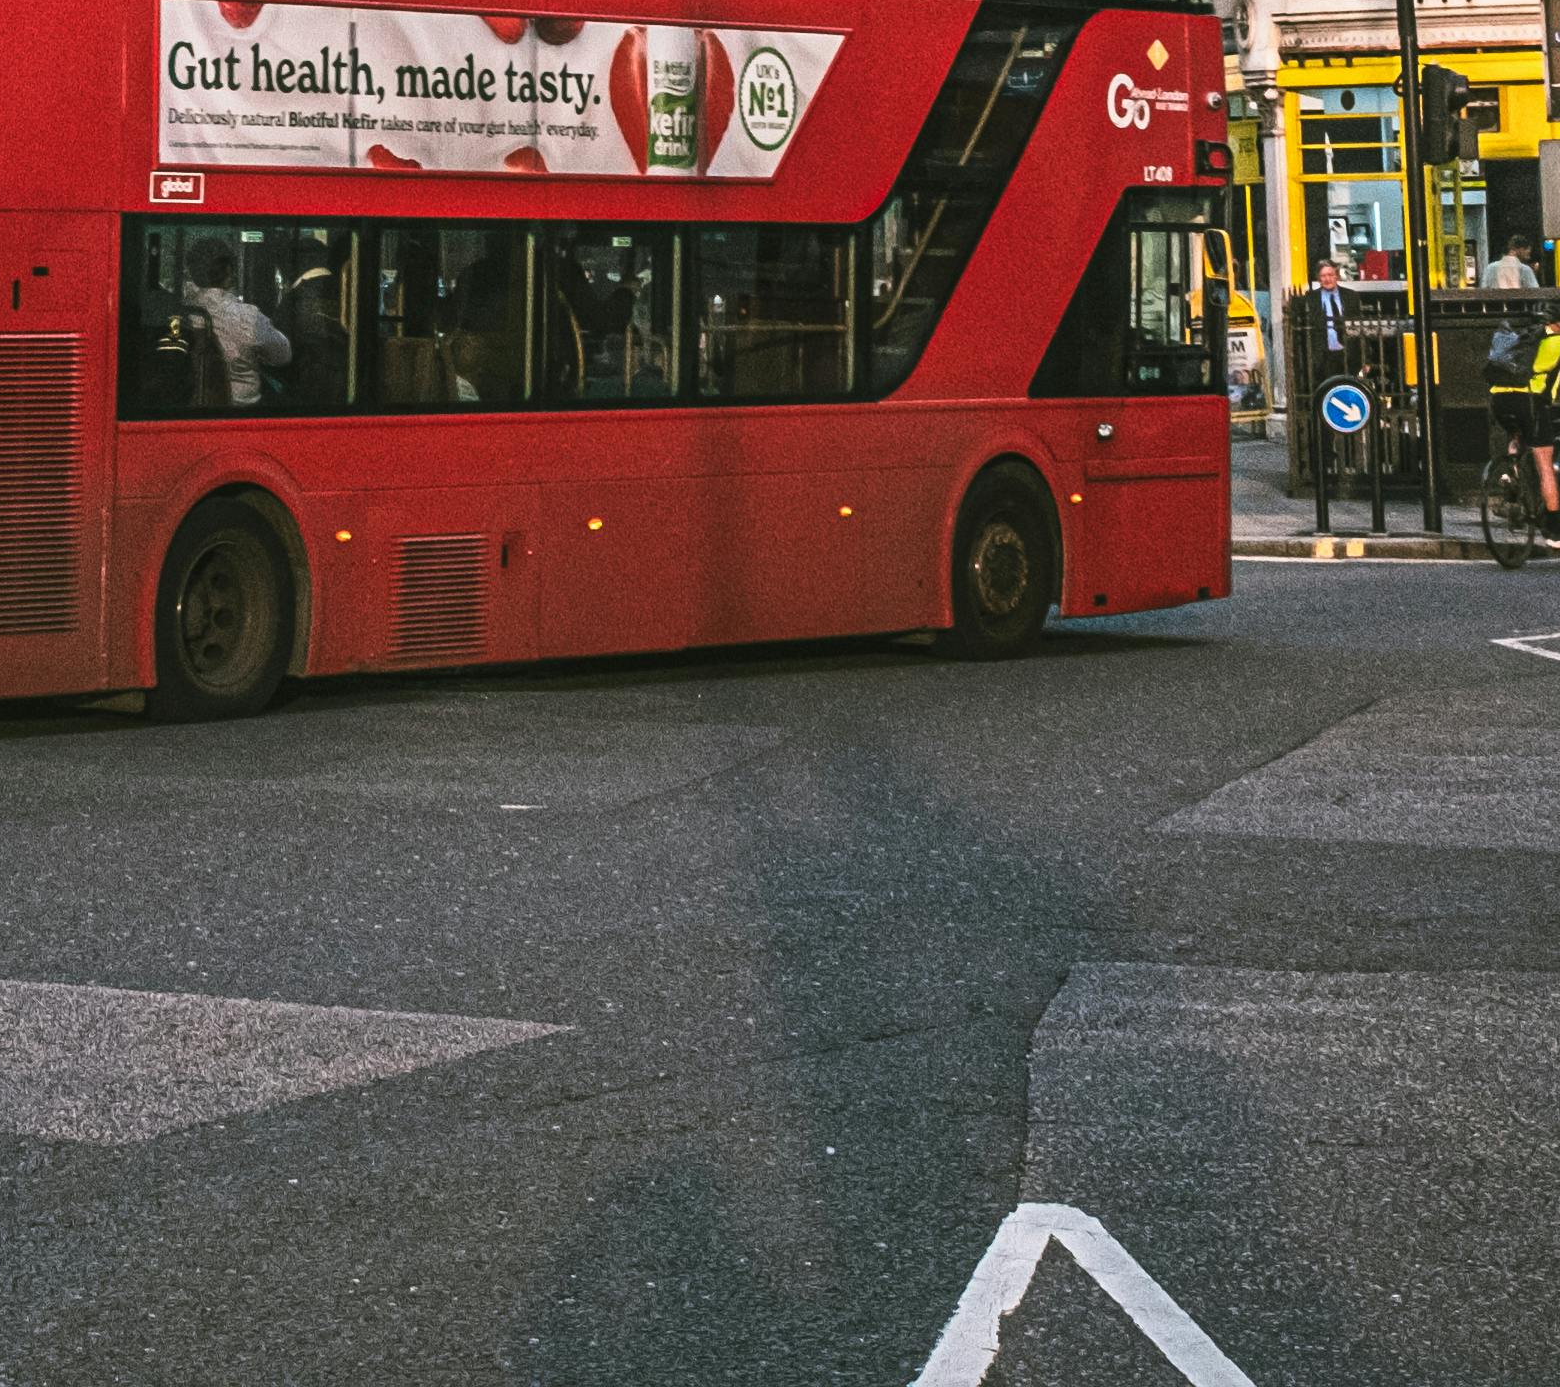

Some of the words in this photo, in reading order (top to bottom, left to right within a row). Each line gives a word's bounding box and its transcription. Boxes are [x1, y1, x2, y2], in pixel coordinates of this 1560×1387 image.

[168, 41, 241, 91] Gut
[251, 42, 386, 104] health,
[395, 53, 497, 101] made
[505, 59, 602, 116] tasty.
[756, 64, 780, 79] UK's
[1107, 73, 1151, 130] Go
[168, 107, 238, 129] Deliciously
[241, 111, 286, 127] natural
[288, 111, 339, 128] Biotiful
[342, 113, 378, 130] Kefir
[381, 115, 414, 132] takes
[416, 121, 442, 133] care
[444, 117, 457, 134] of
[458, 122, 485, 137] your
[487, 121, 505, 138] gut
[650, 106, 695, 136] kefir
[654, 135, 690, 155] drink
